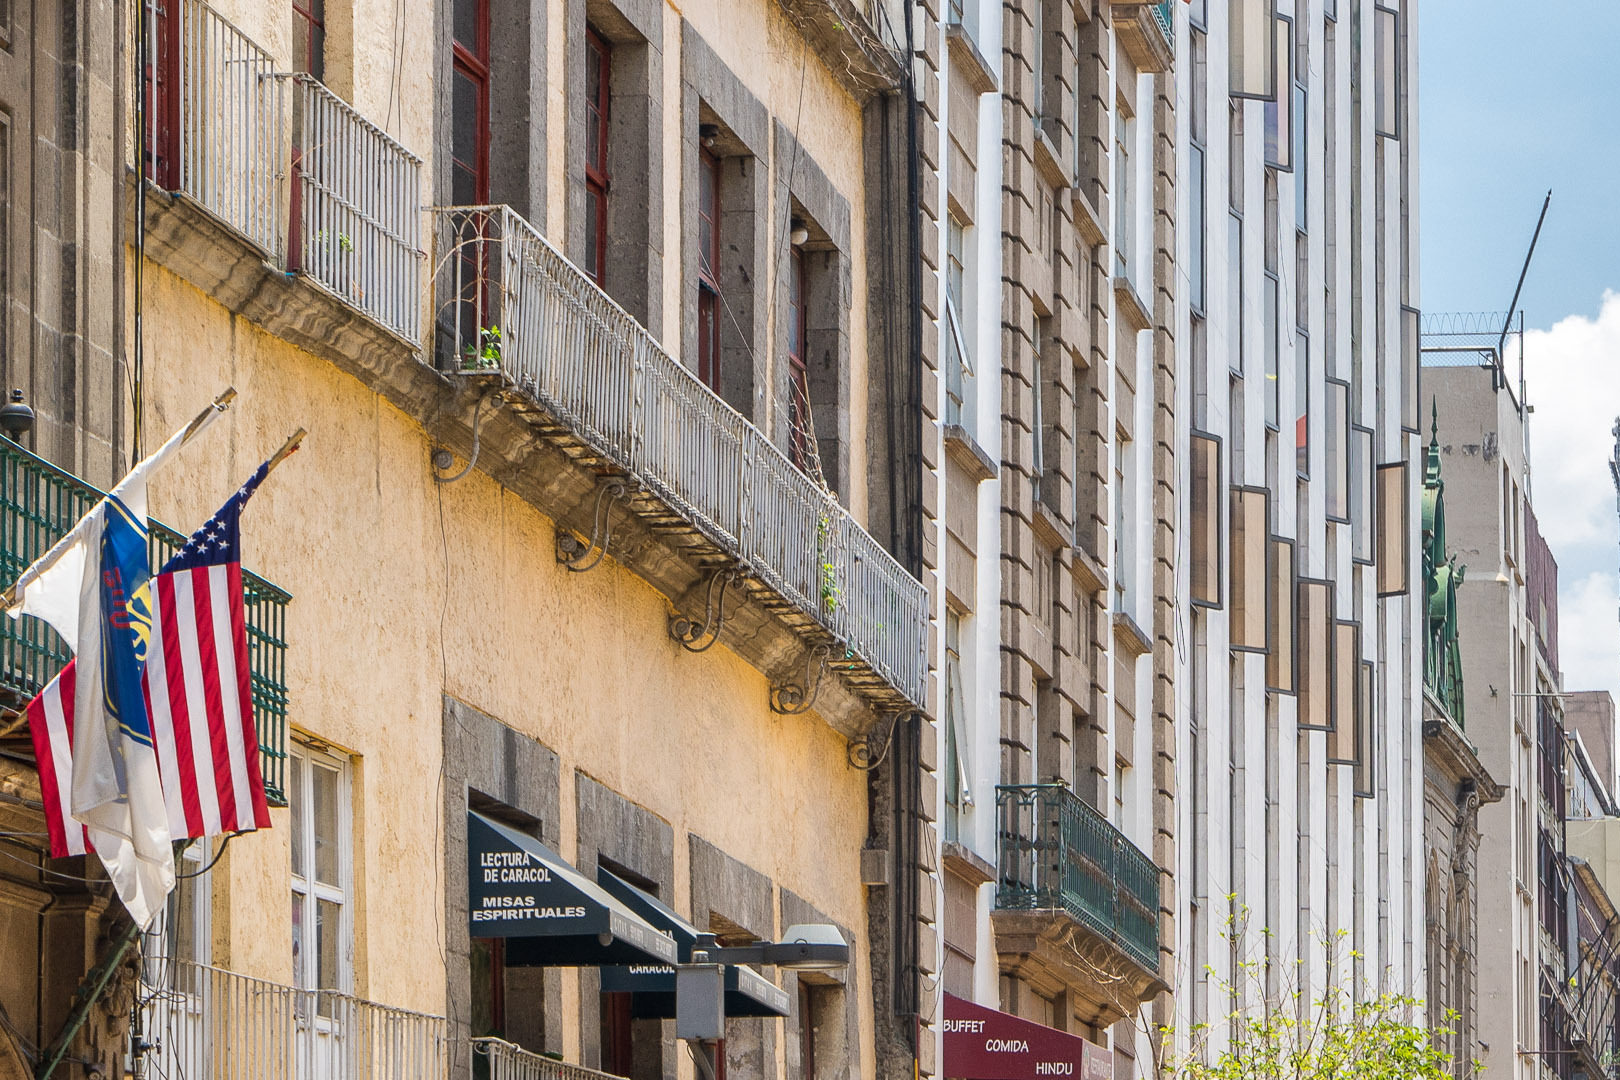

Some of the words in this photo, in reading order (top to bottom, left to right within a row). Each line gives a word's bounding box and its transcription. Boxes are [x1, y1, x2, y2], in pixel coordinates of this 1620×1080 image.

[481, 852, 530, 867] LECTURA
[484, 869, 498, 883] DE
[501, 868, 551, 883] CARACOL
[483, 896, 535, 908] MISAS
[473, 906, 586, 921] ESPIRITUALES
[943, 1019, 985, 1033] BUFFET
[985, 1039, 1029, 1053] COMIDA
[1036, 1062, 1073, 1076] HINDU
